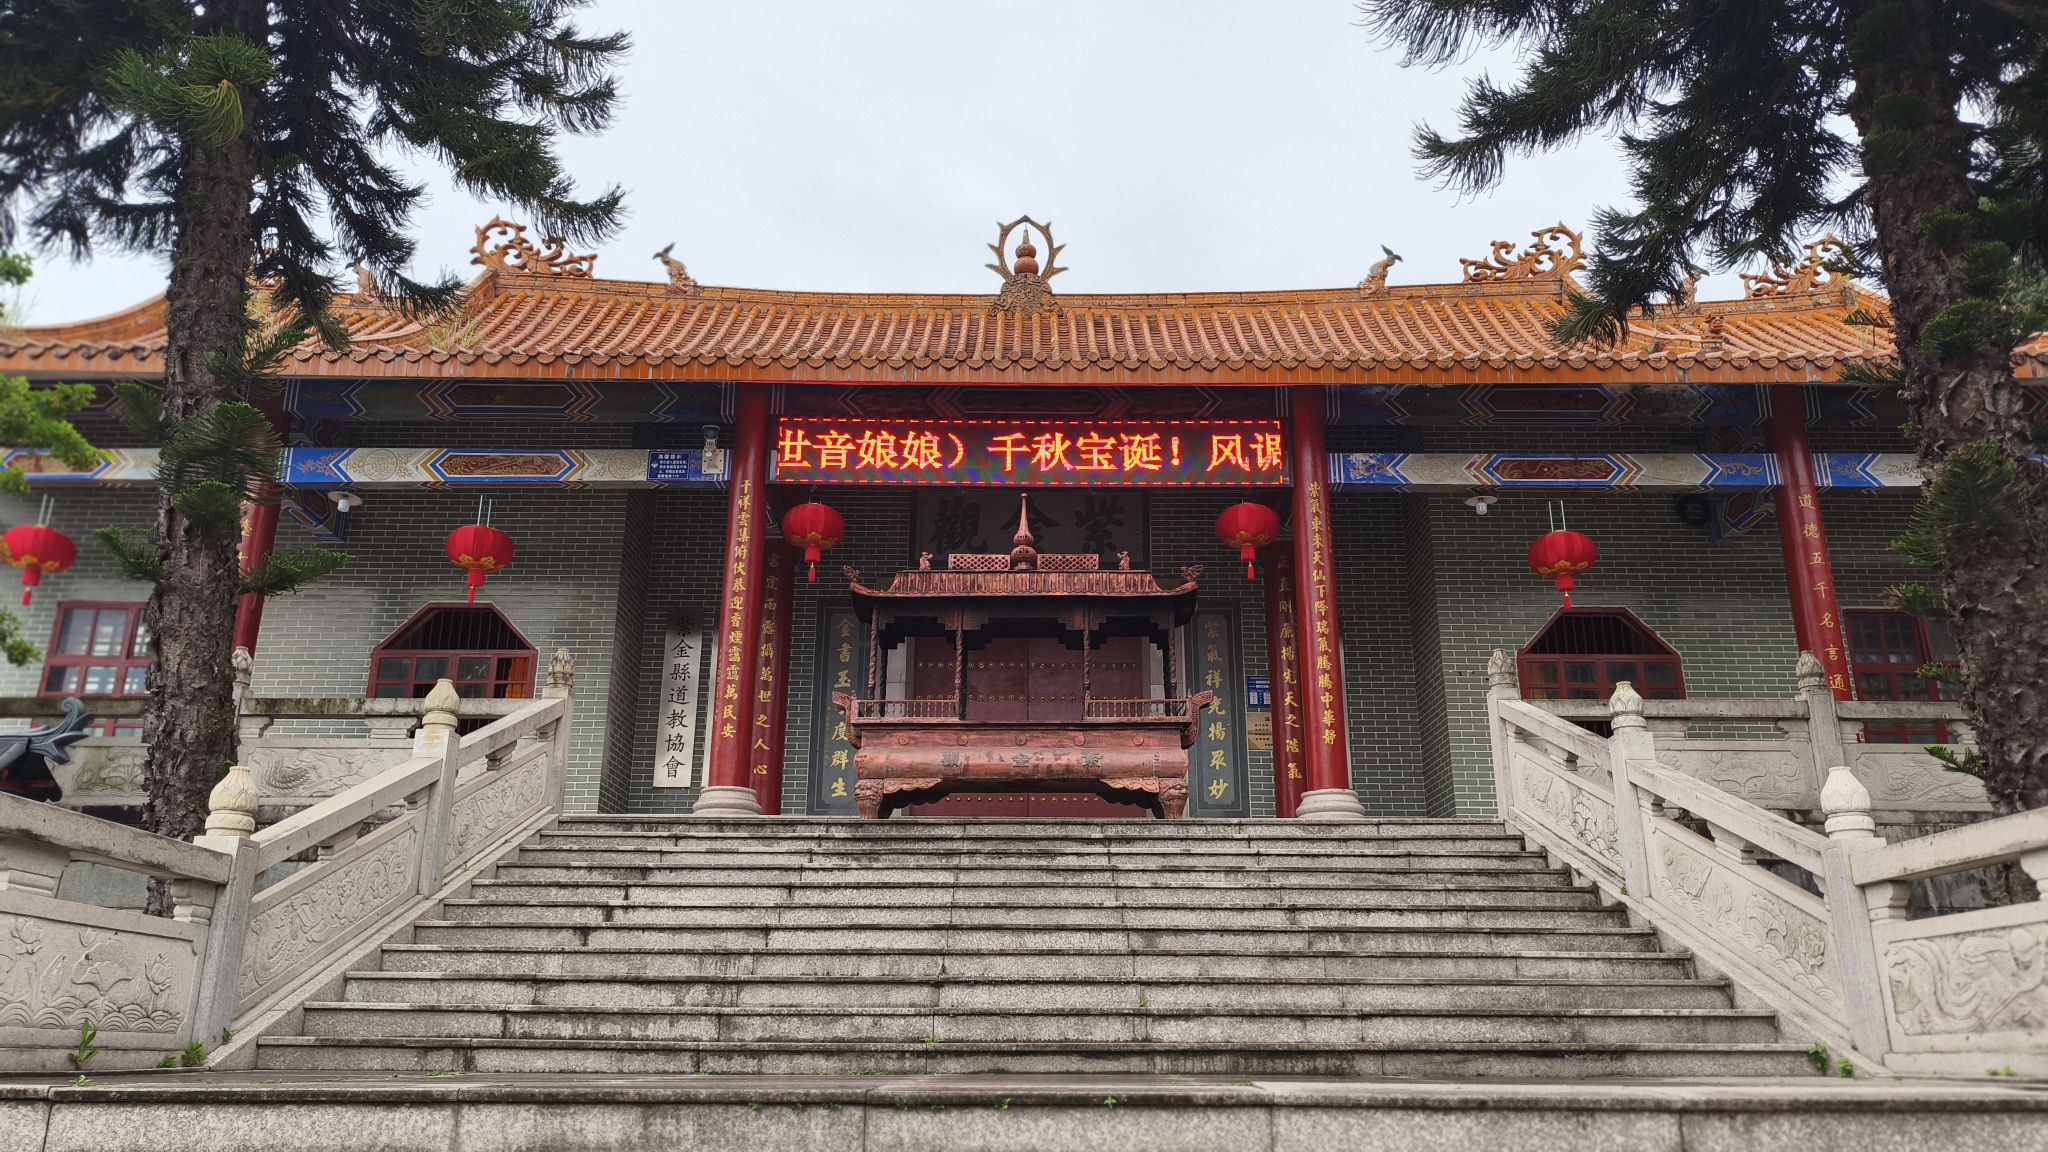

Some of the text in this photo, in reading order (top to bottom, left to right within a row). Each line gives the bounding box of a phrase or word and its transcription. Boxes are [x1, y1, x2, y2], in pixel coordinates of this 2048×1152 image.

[661, 615, 696, 779] 紫金縣道教協會
[830, 616, 856, 798] 金書玉度群生
